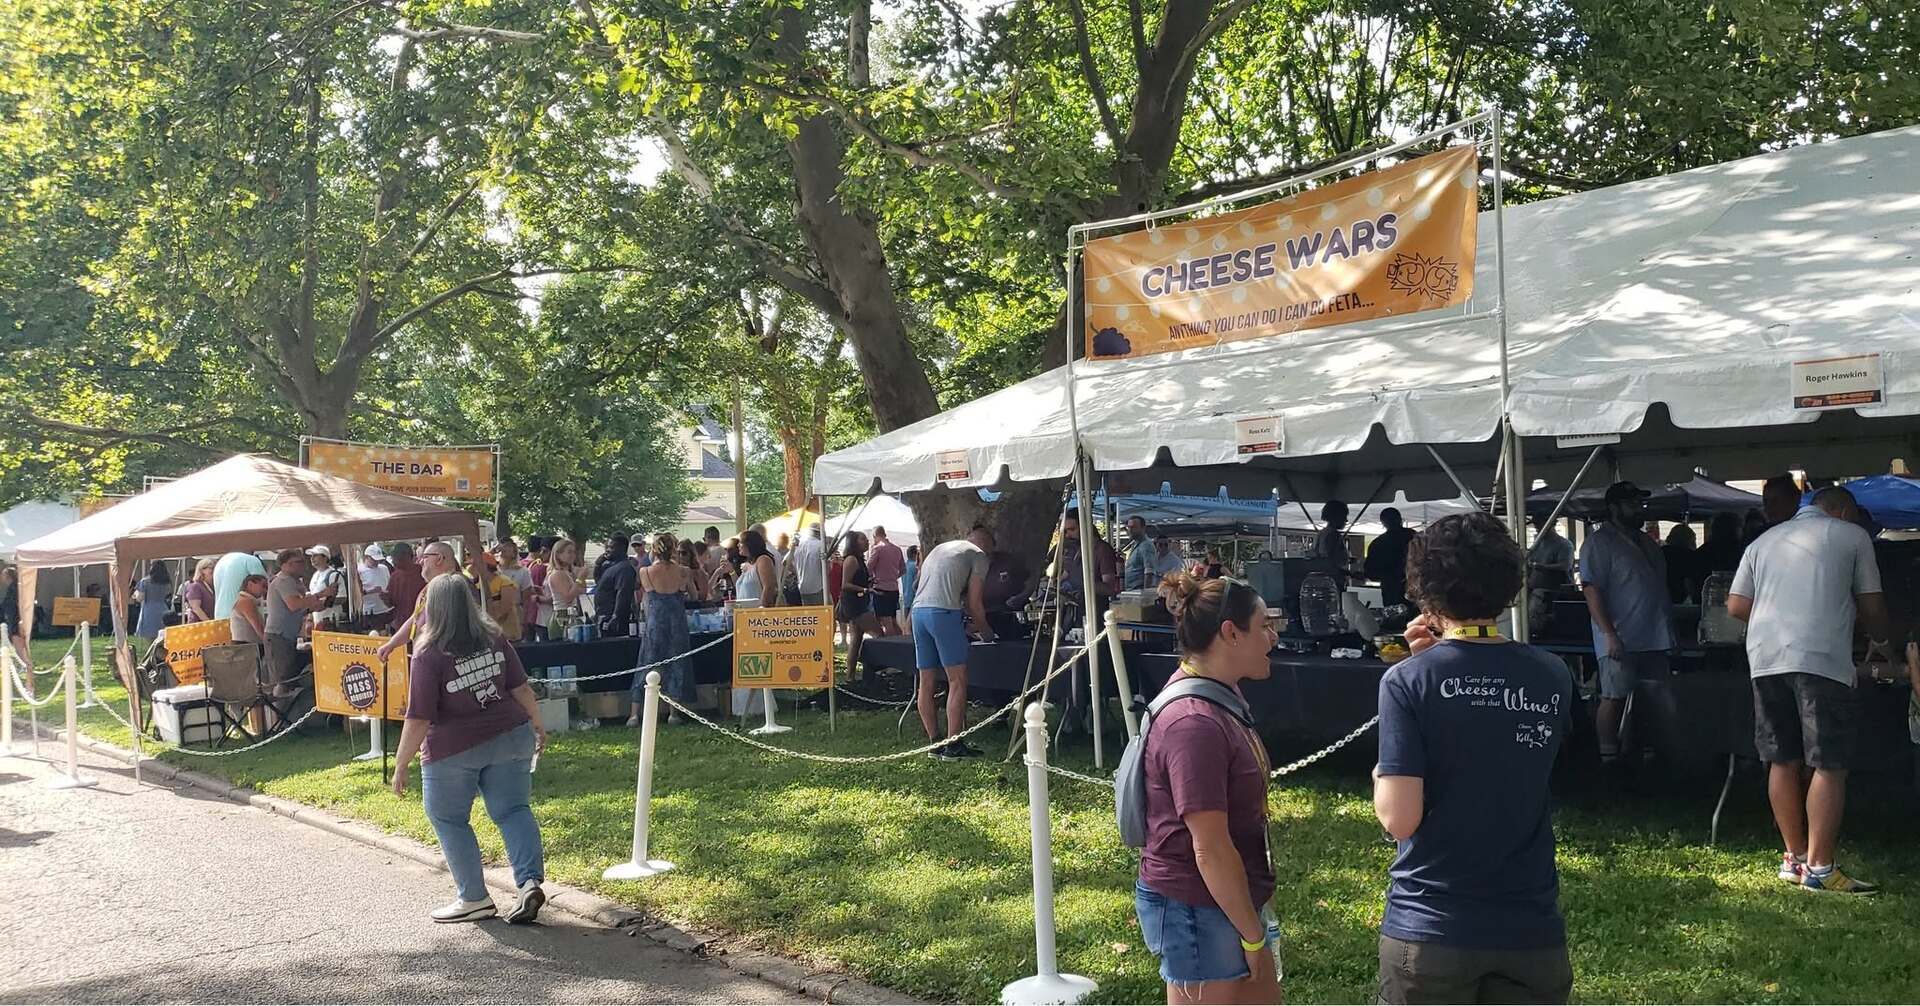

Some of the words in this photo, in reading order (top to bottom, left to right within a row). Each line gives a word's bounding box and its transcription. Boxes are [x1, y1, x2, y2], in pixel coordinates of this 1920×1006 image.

[1141, 242, 1276, 298] CHEESE
[1286, 213, 1398, 271] WARS
[1168, 319, 1210, 340] ANYTHING
[1214, 318, 1235, 334] YOU
[1237, 312, 1259, 329] CAN
[1262, 310, 1276, 325] DO
[1285, 304, 1308, 320] CAN
[1310, 301, 1325, 315] DO
[1328, 293, 1375, 313] FETA...
[1805, 374, 1830, 383] Roger
[1831, 370, 1868, 380] Hawkins
[370, 461, 405, 475] THE
[410, 463, 443, 475] BAR
[748, 616, 819, 627] MAC-N-CHEESE
[752, 628, 816, 639] THROWDOWN
[328, 643, 361, 655] CHEESE
[362, 646, 378, 656] WA
[741, 656, 770, 676] KW
[446, 663, 501, 693] CHEESE
[1464, 676, 1480, 684] Care
[1480, 675, 1492, 686] for
[1492, 678, 1506, 686] any
[347, 679, 371, 695] PASS
[1440, 677, 1500, 698] Cheese
[1471, 698, 1486, 706] with
[1503, 686, 1560, 715] Wine?
